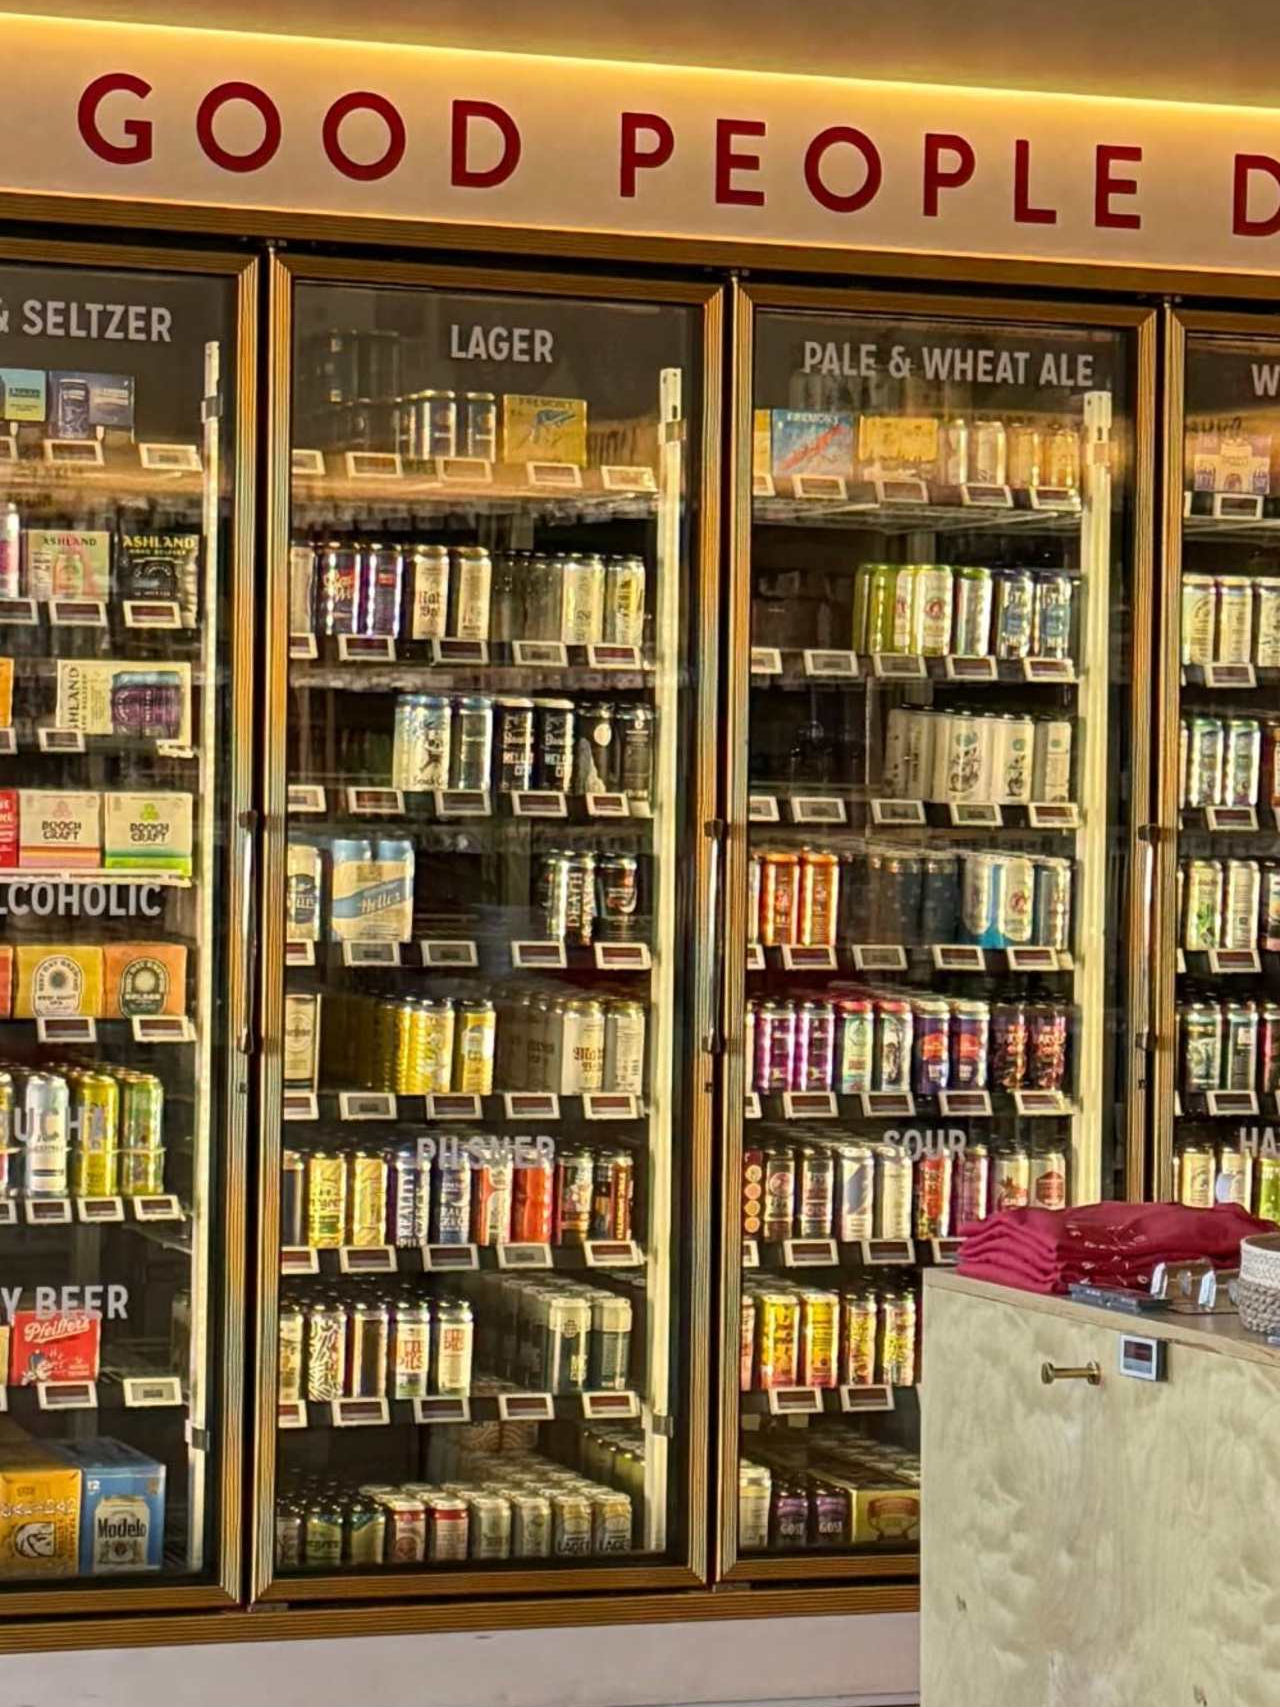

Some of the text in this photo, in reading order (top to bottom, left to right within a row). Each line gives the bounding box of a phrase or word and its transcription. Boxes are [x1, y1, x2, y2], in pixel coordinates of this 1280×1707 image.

[76, 70, 522, 190] GOOD
[618, 109, 1145, 232] PEOPLE
[21, 298, 174, 343] SELTZER
[450, 323, 555, 364] LAGER
[801, 340, 1095, 388] PALE & WHEAT ALE
[42, 536, 98, 547] ASHLAND
[122, 534, 196, 549] ASHLAND
[416, 1135, 556, 1171] PILSNER
[882, 1128, 968, 1163] SOUR
[35, 1283, 130, 1321] BEER
[97, 1516, 147, 1539] Modelo
